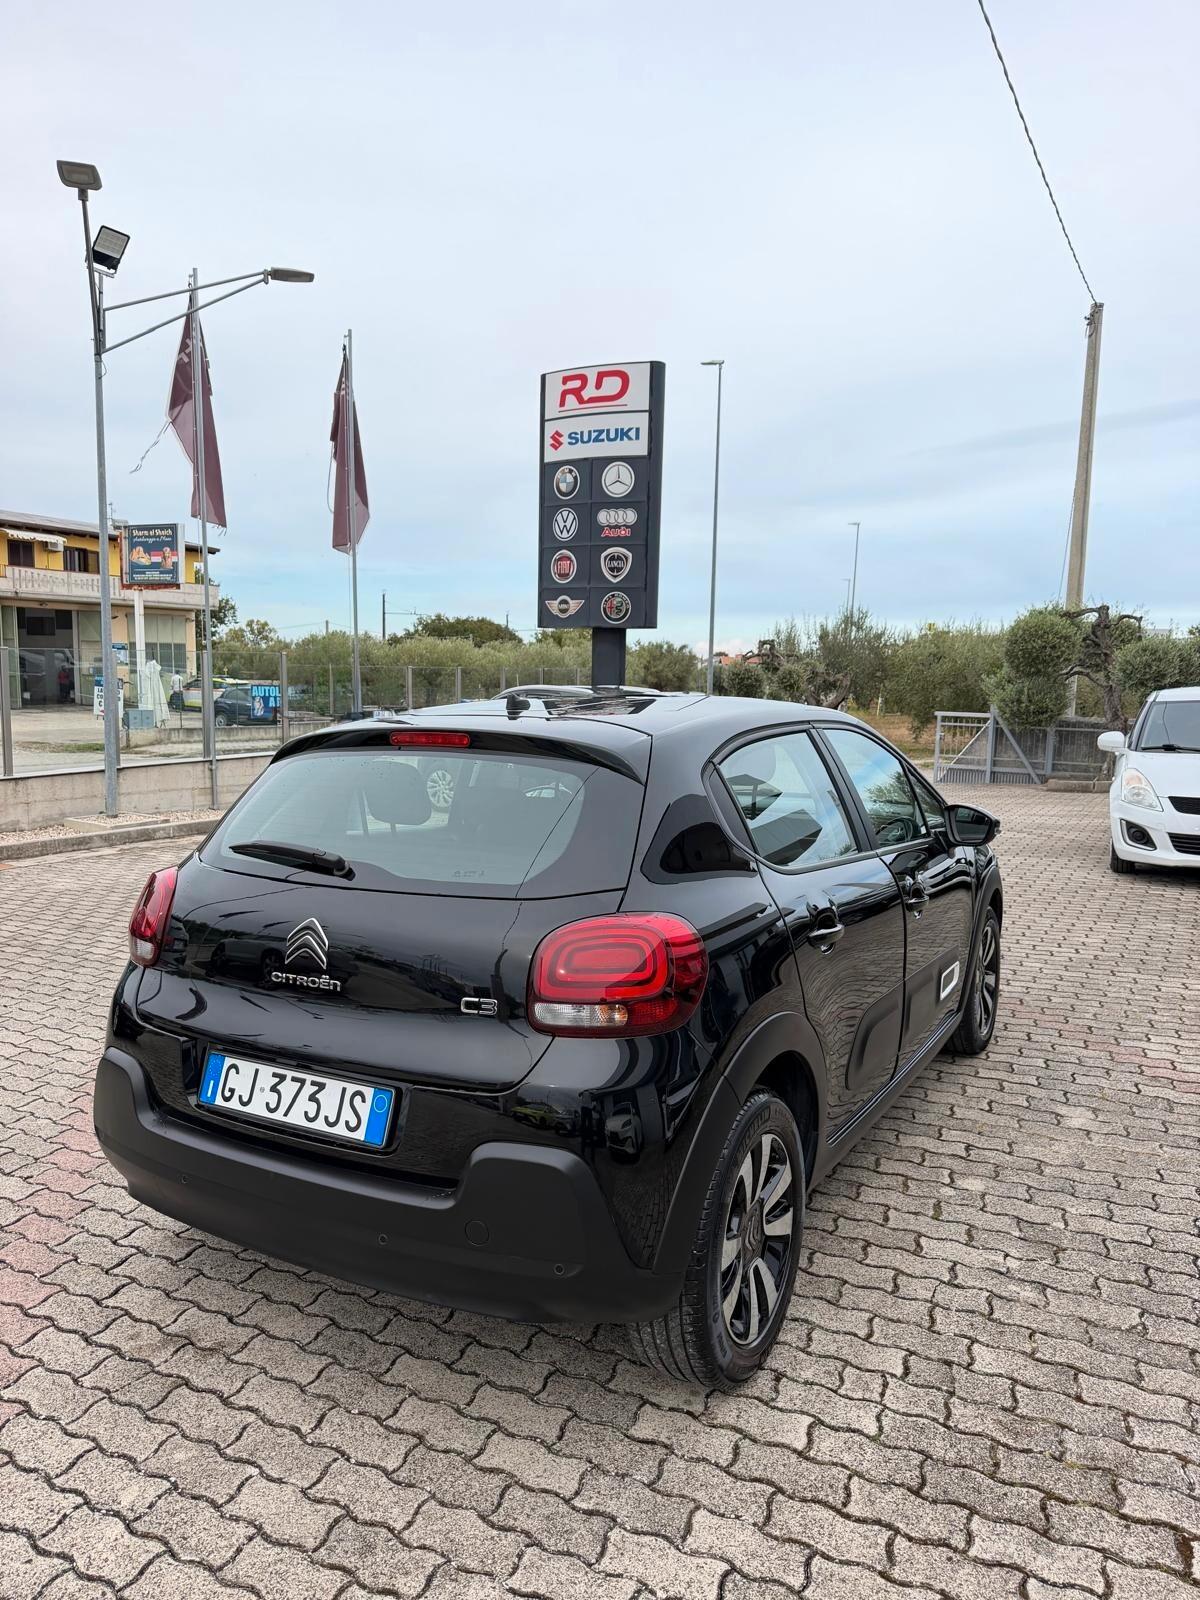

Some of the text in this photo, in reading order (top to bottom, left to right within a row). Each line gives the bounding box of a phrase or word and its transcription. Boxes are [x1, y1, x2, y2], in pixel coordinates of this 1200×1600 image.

[559, 369, 630, 408] RD
[567, 427, 641, 446] SUZUKI
[557, 560, 571, 574] FIAT
[607, 560, 625, 568] LANCIA
[252, 685, 282, 697] AUTOL
[460, 997, 498, 1015] C3
